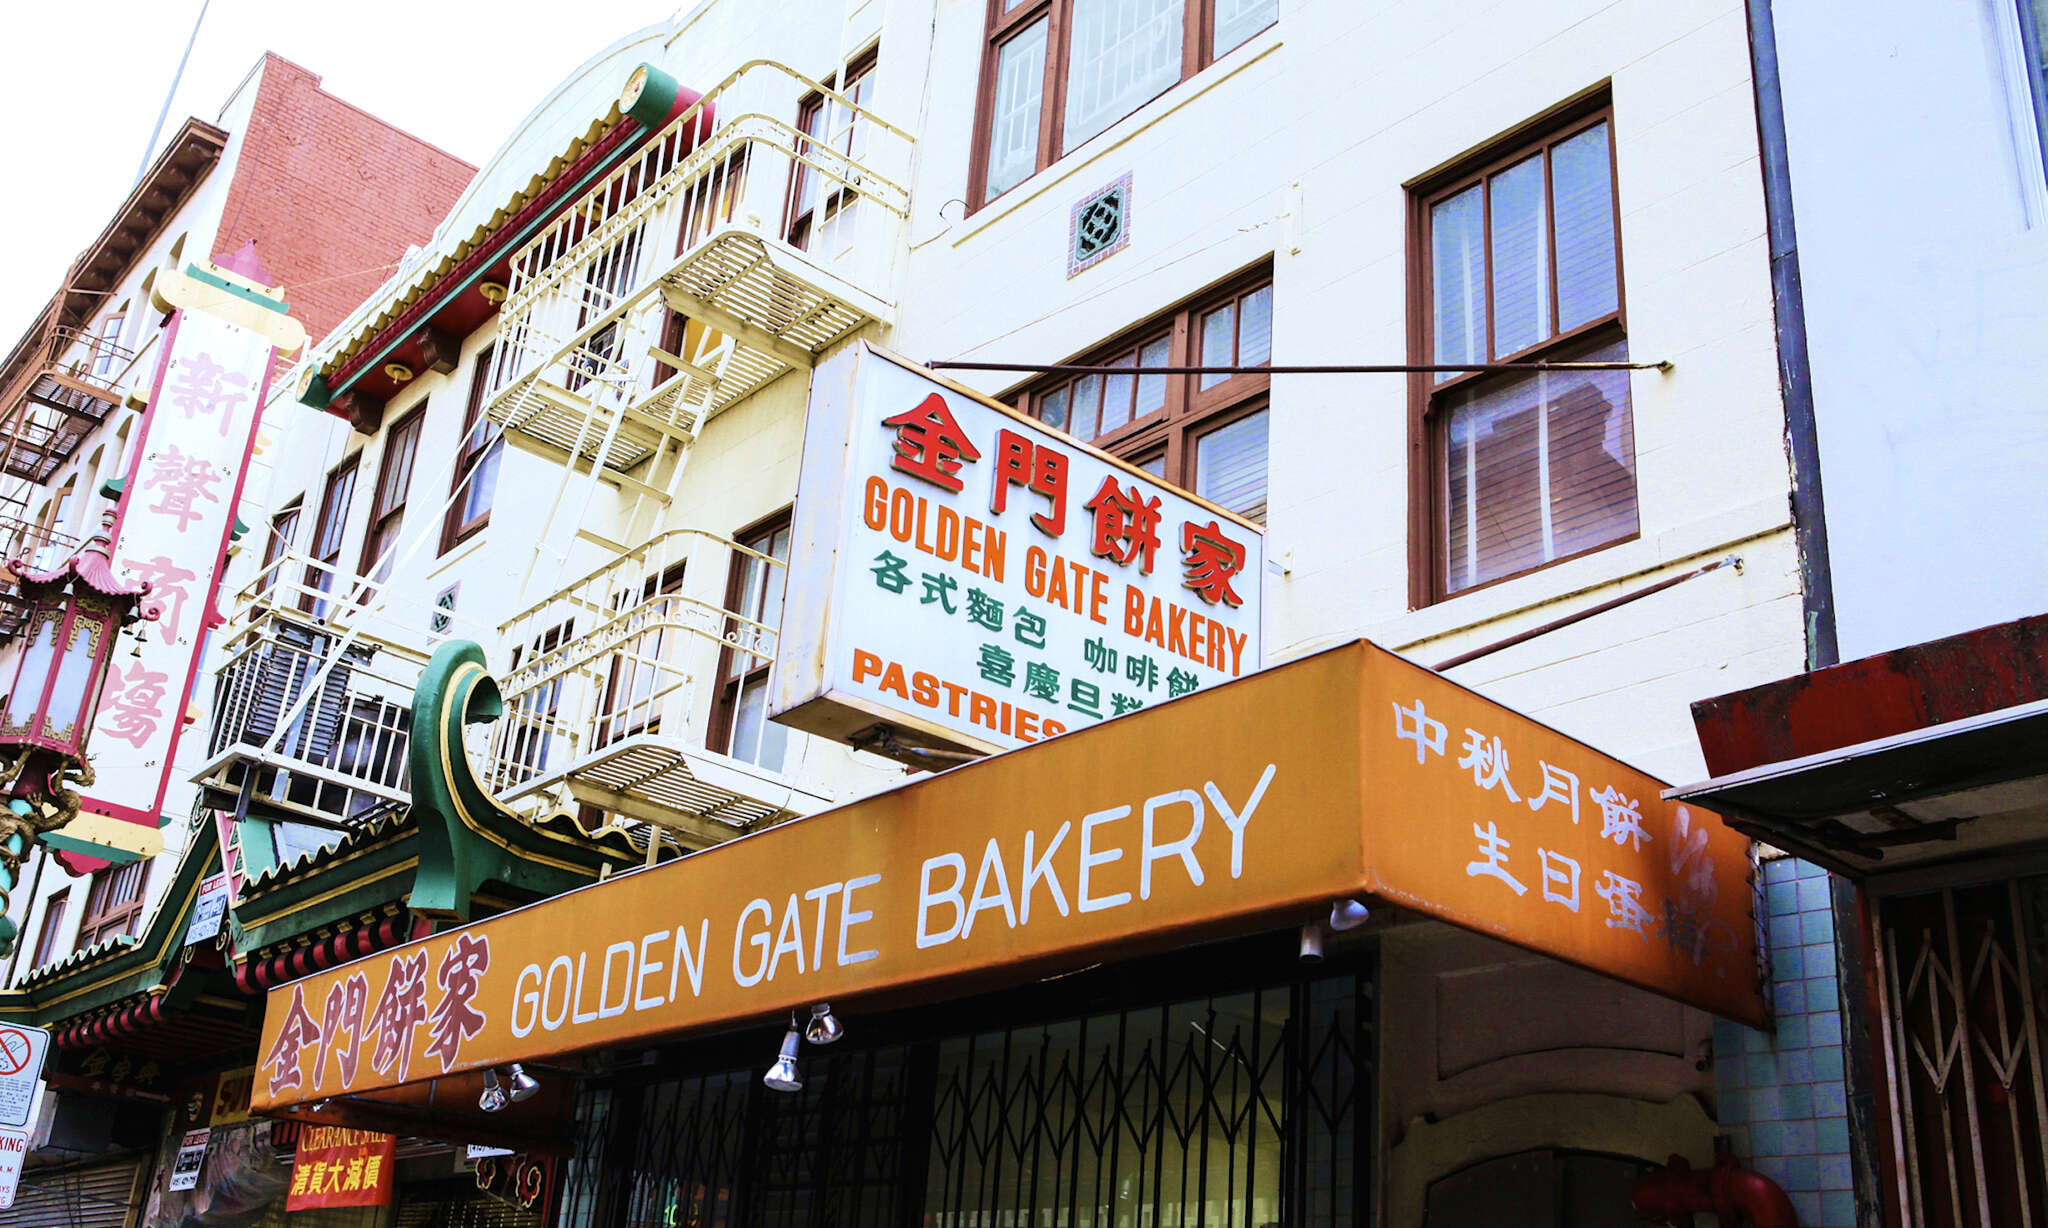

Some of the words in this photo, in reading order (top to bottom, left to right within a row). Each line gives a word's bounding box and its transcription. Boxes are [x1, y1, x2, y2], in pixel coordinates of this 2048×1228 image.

[864, 475, 1006, 583] GOLDEN
[1026, 546, 1109, 625] GATE
[1124, 584, 1248, 677] BAKERY
[880, 392, 1247, 609] 金門餅家
[870, 549, 1047, 650] 各式麵包
[853, 649, 1066, 743] PASTRIES
[1392, 699, 1653, 853] 中秋月餅
[511, 918, 709, 1038] GOLDEN
[733, 873, 881, 987] GATE
[916, 764, 1276, 950] BAKERY
[262, 932, 490, 1098] 金門餅家
